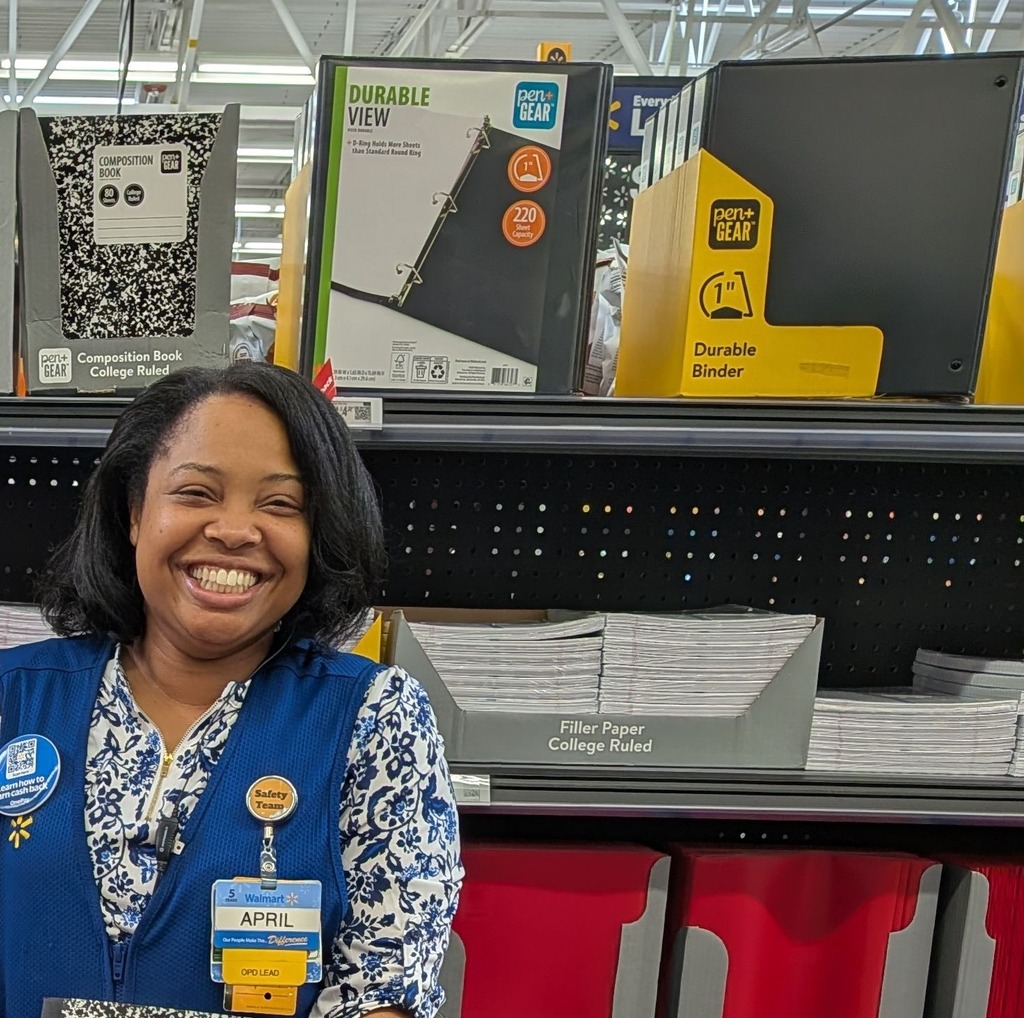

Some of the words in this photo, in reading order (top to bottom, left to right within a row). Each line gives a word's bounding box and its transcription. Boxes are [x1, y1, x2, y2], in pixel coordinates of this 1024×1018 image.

[349, 84, 431, 107] DURABLE
[348, 106, 391, 127] VIEW
[520, 103, 551, 122] GEAR
[513, 206, 536, 223] 220
[512, 230, 534, 240] Capacity
[516, 223, 530, 232] Sheet
[716, 221, 751, 242] GEAR
[714, 281, 736, 304] 1"
[694, 342, 757, 358] Durable
[77, 352, 150, 366] Composition
[154, 350, 182, 362] Book
[89, 364, 134, 378] College
[136, 364, 170, 377] Ruled
[692, 364, 744, 379] Binder
[559, 721, 598, 736] Filler
[602, 722, 645, 739] Paper
[548, 737, 606, 755] College
[610, 738, 652, 754] Ruled
[18, 778, 35, 786] how
[11, 787, 29, 797] cash
[29, 783, 48, 793] back
[254, 788, 287, 801] Safety
[255, 800, 284, 810] Team
[229, 889, 236, 898] 5
[245, 894, 285, 903] Walmart
[240, 911, 294, 928] APRIL
[259, 969, 279, 977] LEAD
